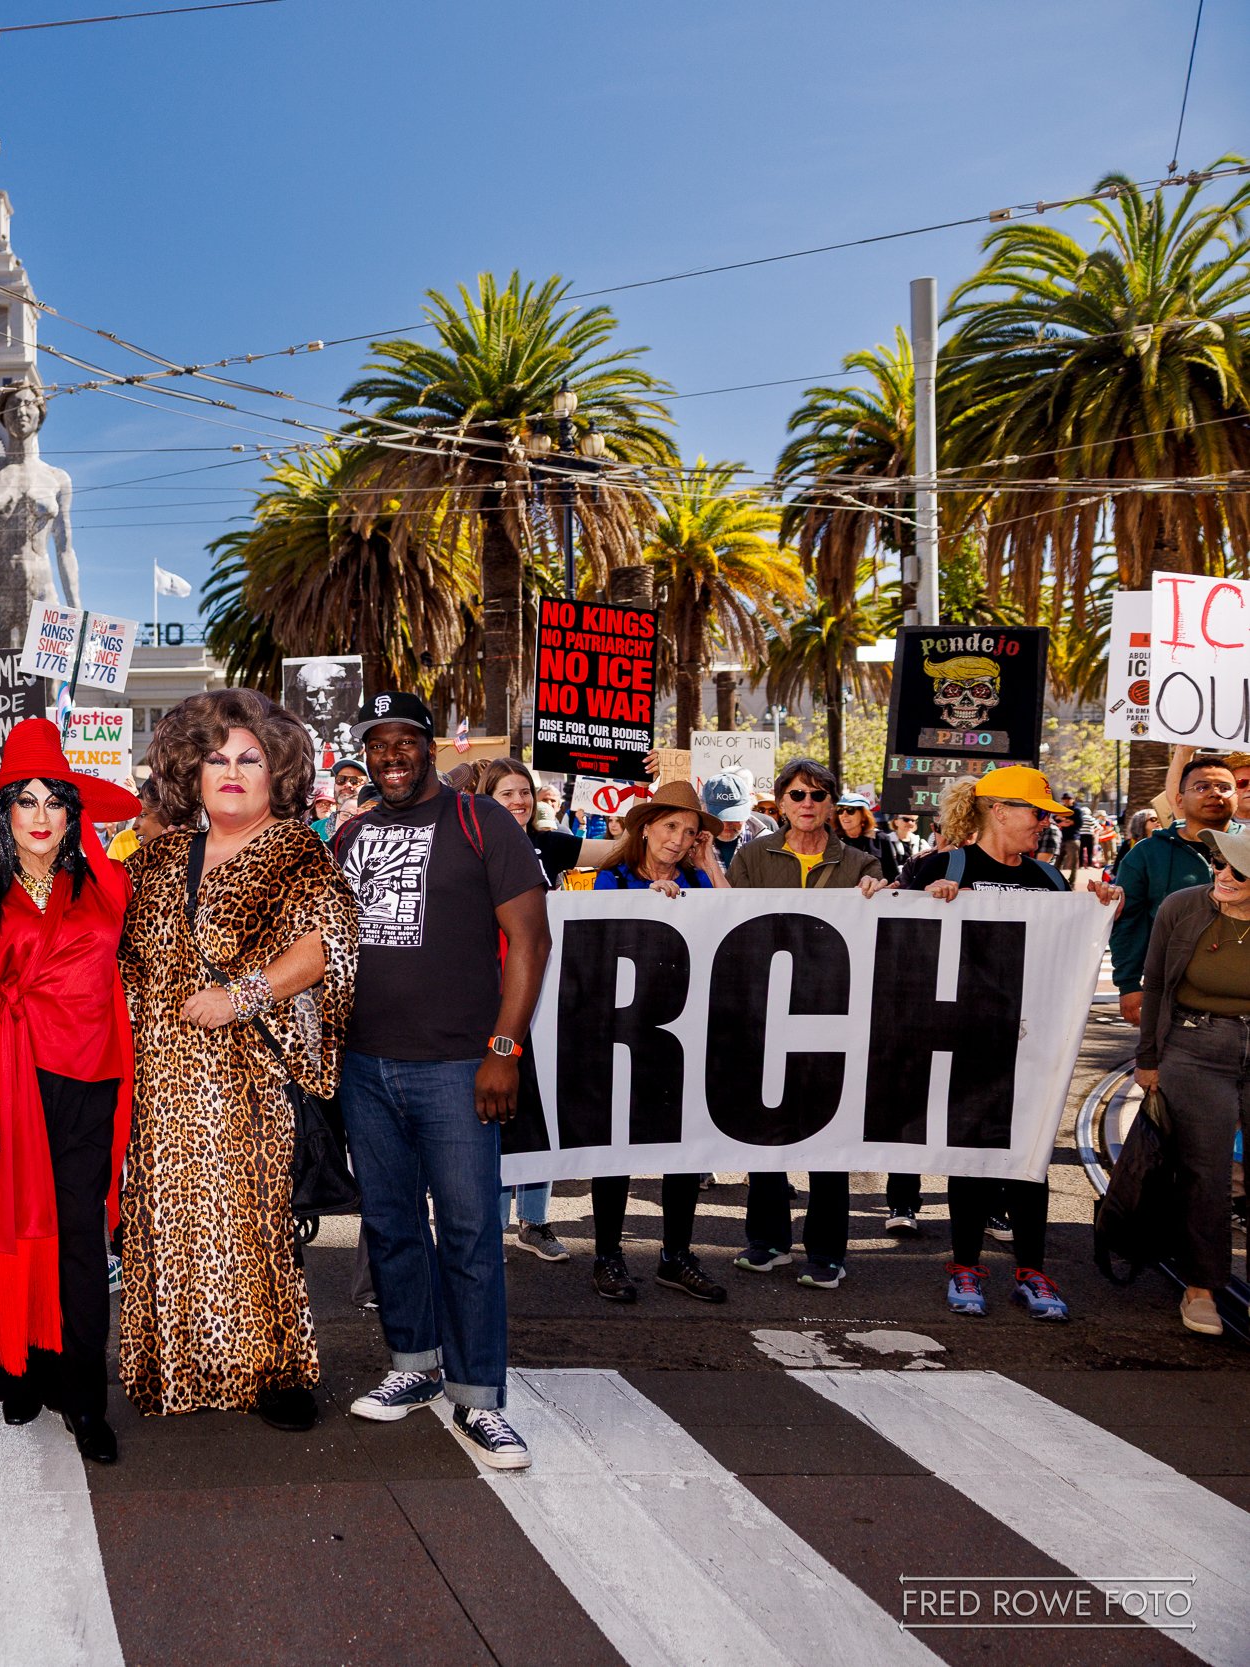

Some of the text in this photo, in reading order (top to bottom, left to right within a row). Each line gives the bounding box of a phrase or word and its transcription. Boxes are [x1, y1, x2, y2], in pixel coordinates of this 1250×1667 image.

[43, 609, 59, 624] NO
[542, 600, 655, 639] NO KINGS
[1158, 578, 1245, 648] IC
[40, 623, 74, 642] KINGS
[541, 628, 654, 658] NO PATRIARCHY
[35, 652, 68, 673] 1776
[539, 647, 653, 692] NO ICE
[1128, 660, 1150, 677] IC
[374, 695, 392, 717] SF
[538, 682, 651, 723] NO WAR
[1156, 671, 1250, 743] OU
[56, 710, 123, 728] justice
[83, 725, 123, 742] LAW
[537, 731, 650, 753] OUR EARTH, OUR FUTURE
[539, 718, 651, 744] RISE FOR OUR BODIES,
[694, 735, 771, 749] NONE OF THIS
[936, 730, 992, 746] PEDO
[64, 749, 122, 765] TANCE
[720, 754, 744, 769] OK
[890, 757, 900, 772] I
[967, 760, 1030, 774] HA
[405, 841, 429, 863] We
[401, 866, 422, 889] Are
[397, 891, 421, 923] Here
[502, 912, 1027, 1154] RCH
